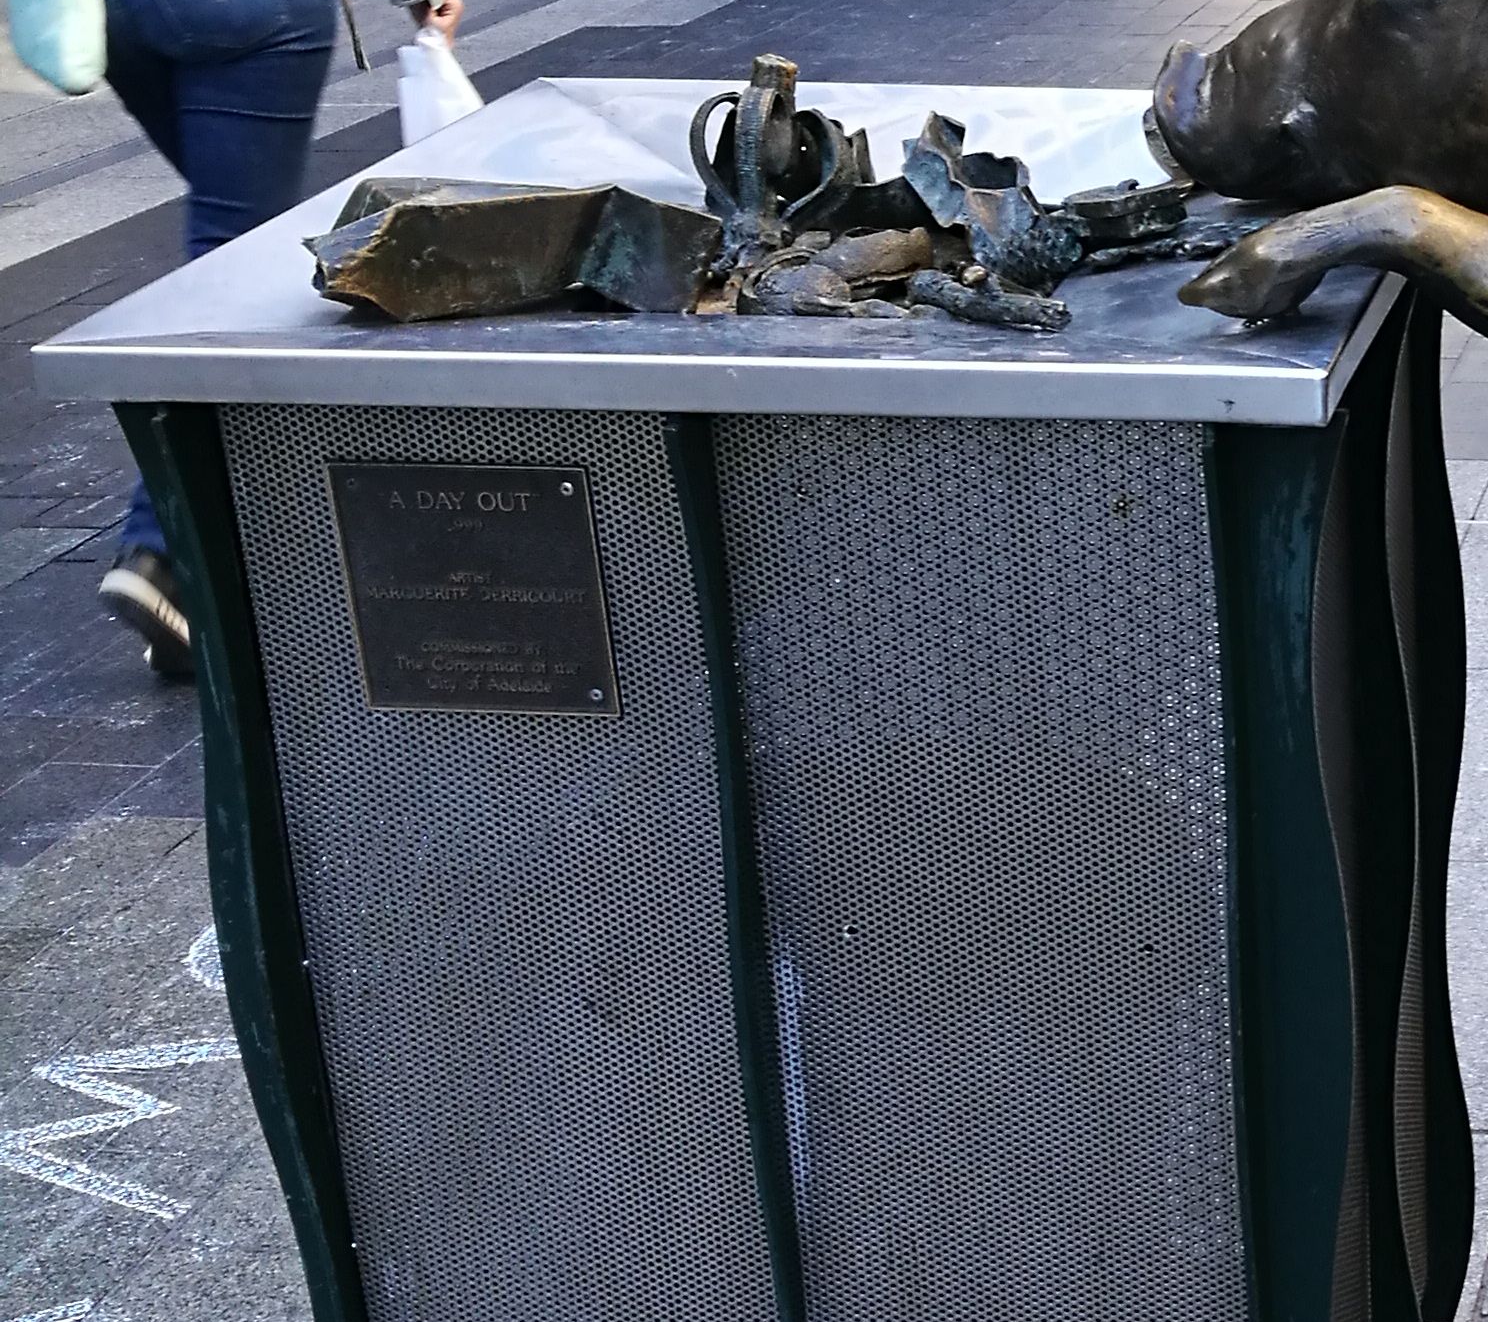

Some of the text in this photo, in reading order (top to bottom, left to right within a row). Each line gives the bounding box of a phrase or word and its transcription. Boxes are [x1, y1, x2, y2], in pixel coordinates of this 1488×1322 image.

[416, 490, 465, 510] DAY
[367, 585, 470, 601] MARGUERITE
[396, 654, 425, 670] The
[431, 655, 525, 674] Corporation
[531, 661, 547, 674] of
[427, 674, 551, 694] City of Adelaide
